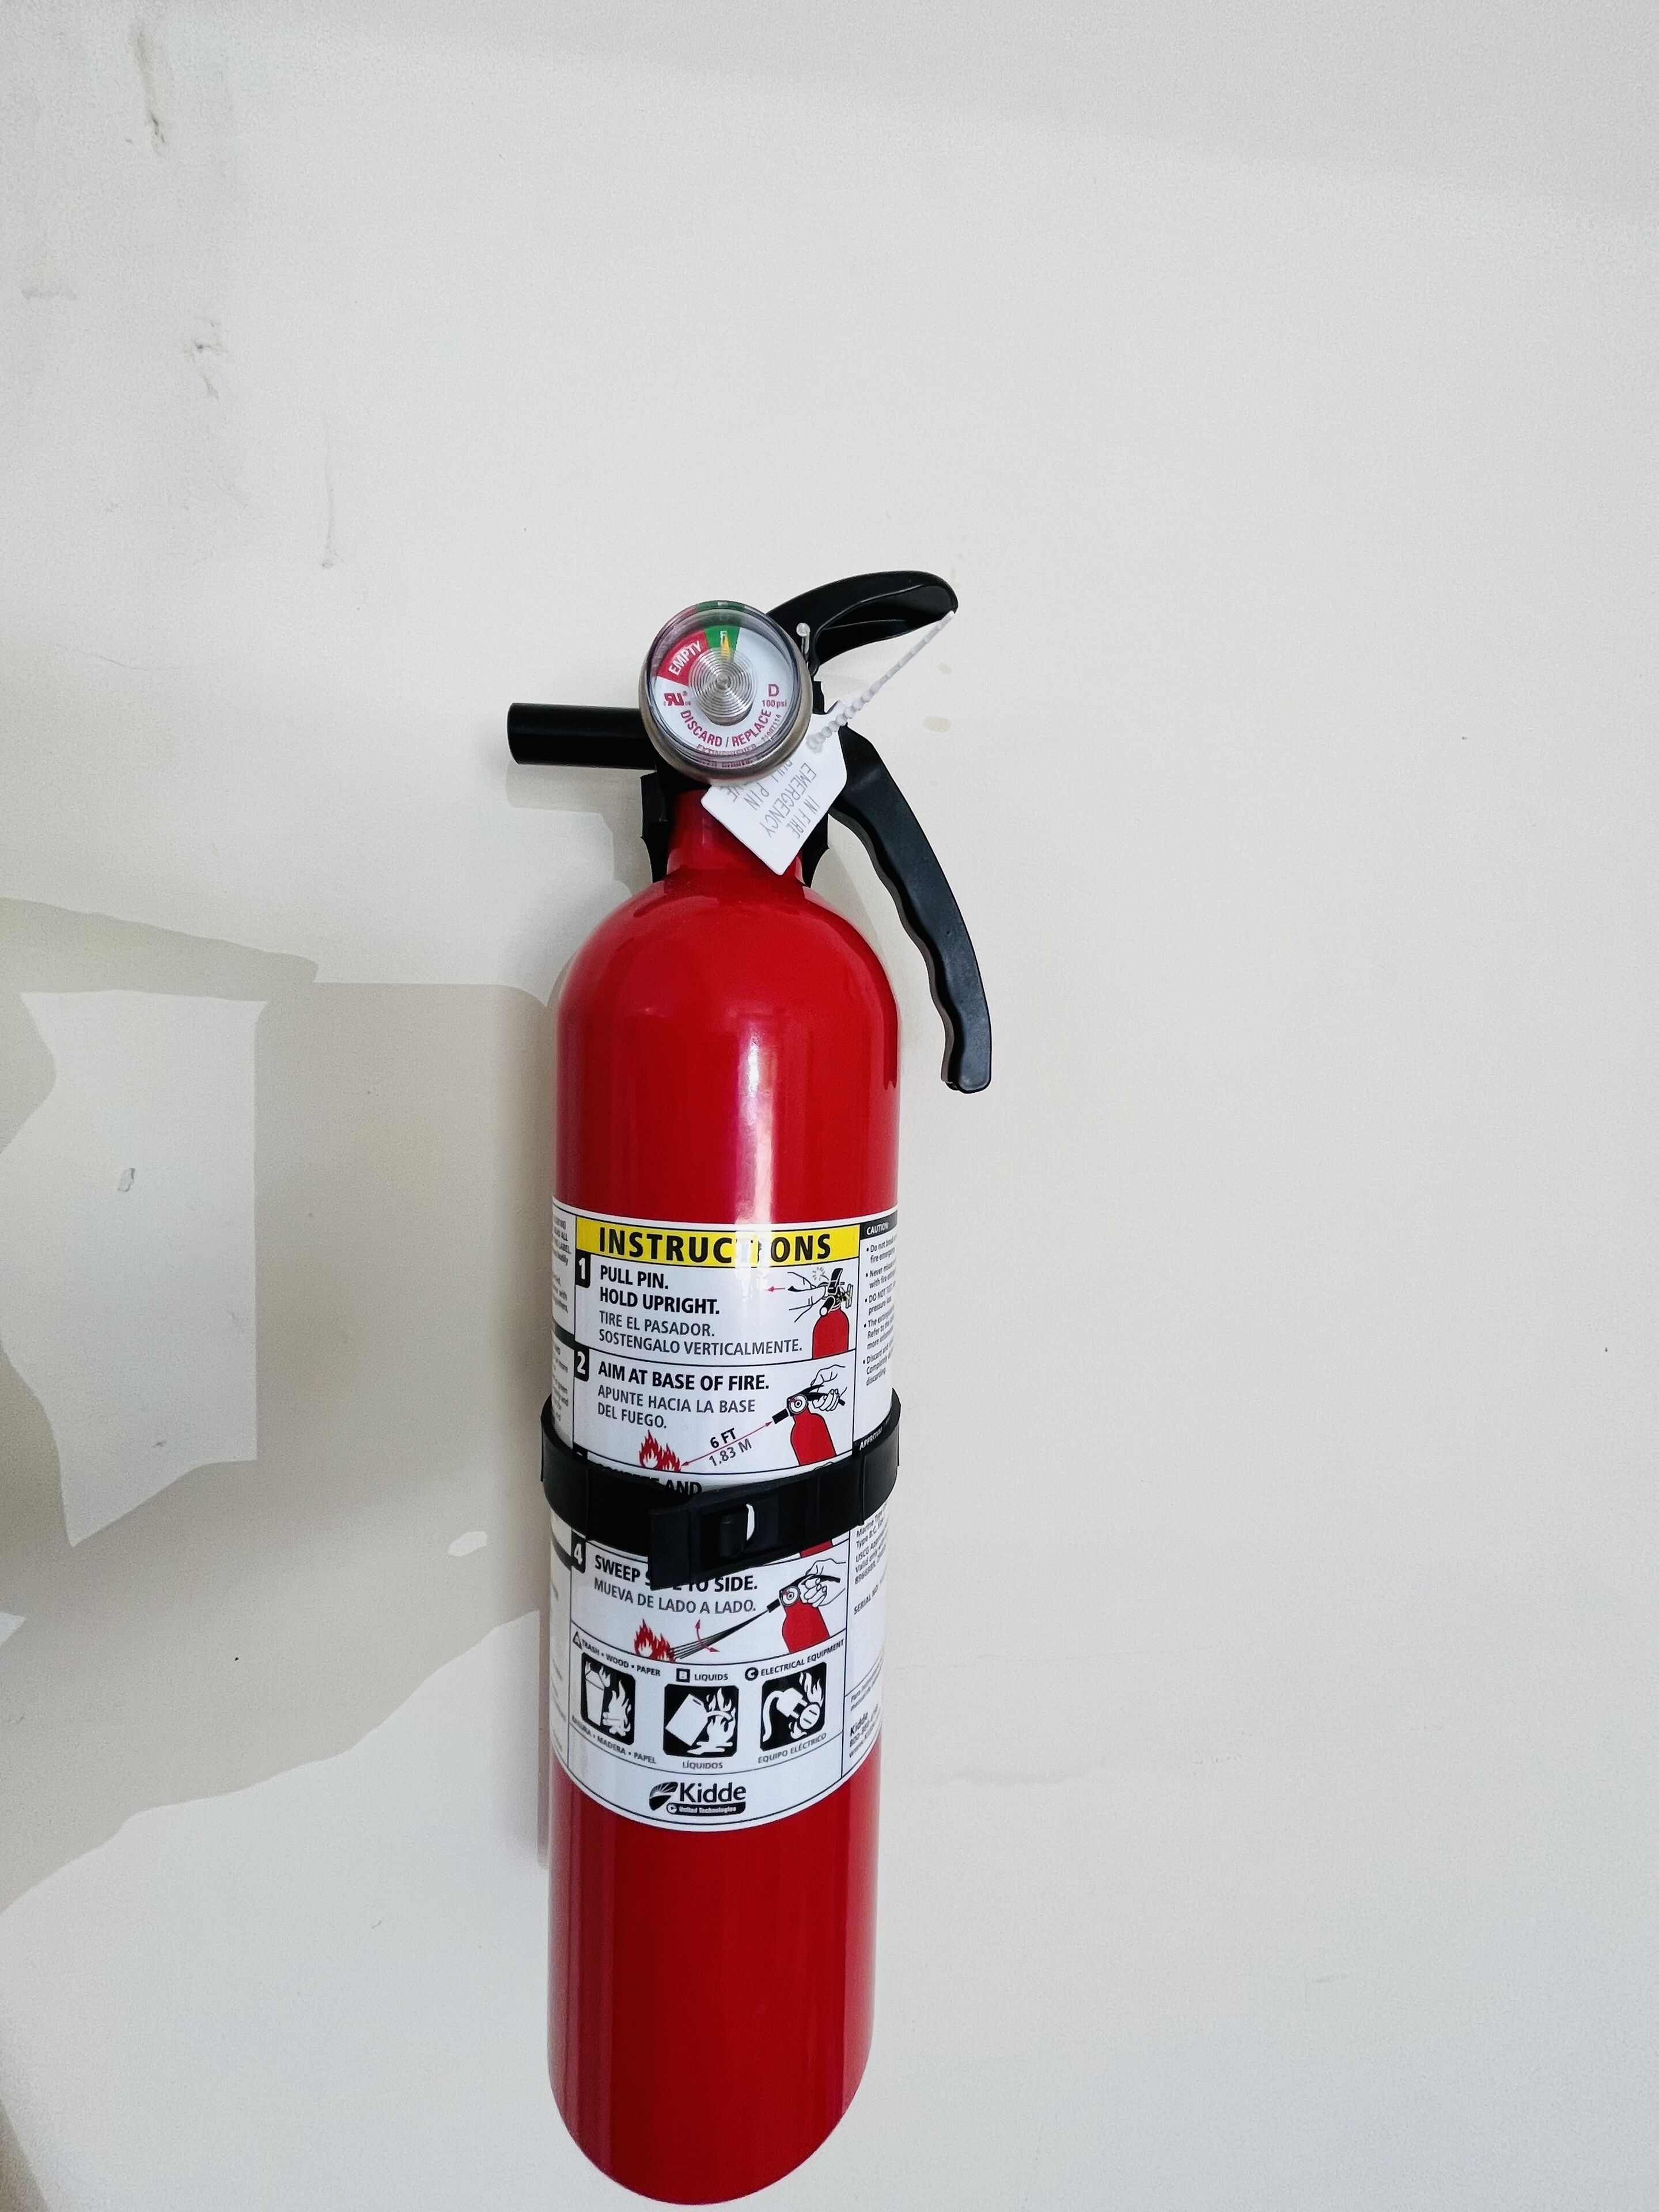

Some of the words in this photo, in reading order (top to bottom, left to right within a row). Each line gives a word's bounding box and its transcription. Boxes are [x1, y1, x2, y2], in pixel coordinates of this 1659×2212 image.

[668, 641, 702, 676] EMPTY
[768, 684, 779, 696] D
[776, 699, 787, 709] psi
[681, 710, 722, 747] DISCARD
[732, 709, 771, 747] REPLACE
[759, 763, 816, 838] EMERGENCY
[804, 795, 820, 814] IN
[786, 808, 811, 838] FIRE
[866, 1222, 888, 1235] CAUTION
[600, 1227, 831, 1263] INSTRUCONS
[578, 1257, 586, 1279] 1
[600, 1265, 633, 1285] PULL
[637, 1271, 669, 1289] PIN.
[600, 1287, 638, 1307] HOLD
[643, 1294, 720, 1315] UPRIGHT.
[869, 1294, 876, 1303] DO
[600, 1310, 622, 1328] TIRE
[627, 1317, 640, 1331] EL
[645, 1319, 715, 1336] PASADOR.
[600, 1329, 680, 1353] SOSTENGALO
[684, 1339, 802, 1355] VERTICALMENTE.
[577, 1351, 586, 1374] 2
[599, 1361, 625, 1381] AIM
[628, 1368, 647, 1385] AT
[652, 1372, 695, 1389] BASE
[700, 1376, 723, 1391] OF
[728, 1374, 770, 1391] FIRE.
[598, 1385, 643, 1407] APUNTE
[649, 1395, 691, 1412] HACIA
[696, 1400, 714, 1413] LA
[720, 1399, 756, 1412] BASE
[598, 1402, 618, 1419] DEL
[622, 1409, 666, 1429] FUEGO.
[710, 1437, 719, 1448] 6
[721, 1427, 736, 1444] FT
[709, 1446, 736, 1467] 1.83
[738, 1438, 752, 1453] M
[664, 1479, 702, 1495] AND
[574, 1543, 582, 1565] 4
[595, 1554, 641, 1582] SWEEP
[714, 1575, 757, 1592] SIDE.
[594, 1577, 633, 1604] MUEVA
[638, 1593, 654, 1608] DE
[659, 1597, 696, 1613] LADO
[700, 1601, 710, 1613] A
[715, 1600, 756, 1613] LADO.
[582, 1639, 600, 1656] TRASH
[605, 1654, 629, 1668] WOOD
[637, 1665, 661, 1677] PAPER
[761, 1659, 805, 1676] ELECTRICAL
[806, 1639, 844, 1663] EQUIPMENT
[694, 1673, 728, 1681] LIQUIDS
[597, 1735, 626, 1755] MADERA
[634, 1752, 656, 1764] PAPEL
[758, 1750, 788, 1763] EQUIPO
[790, 1733, 827, 1754] ELÉCTRICO
[683, 1759, 723, 1770] LÍQUIDOS
[680, 1782, 746, 1803] Kidde
